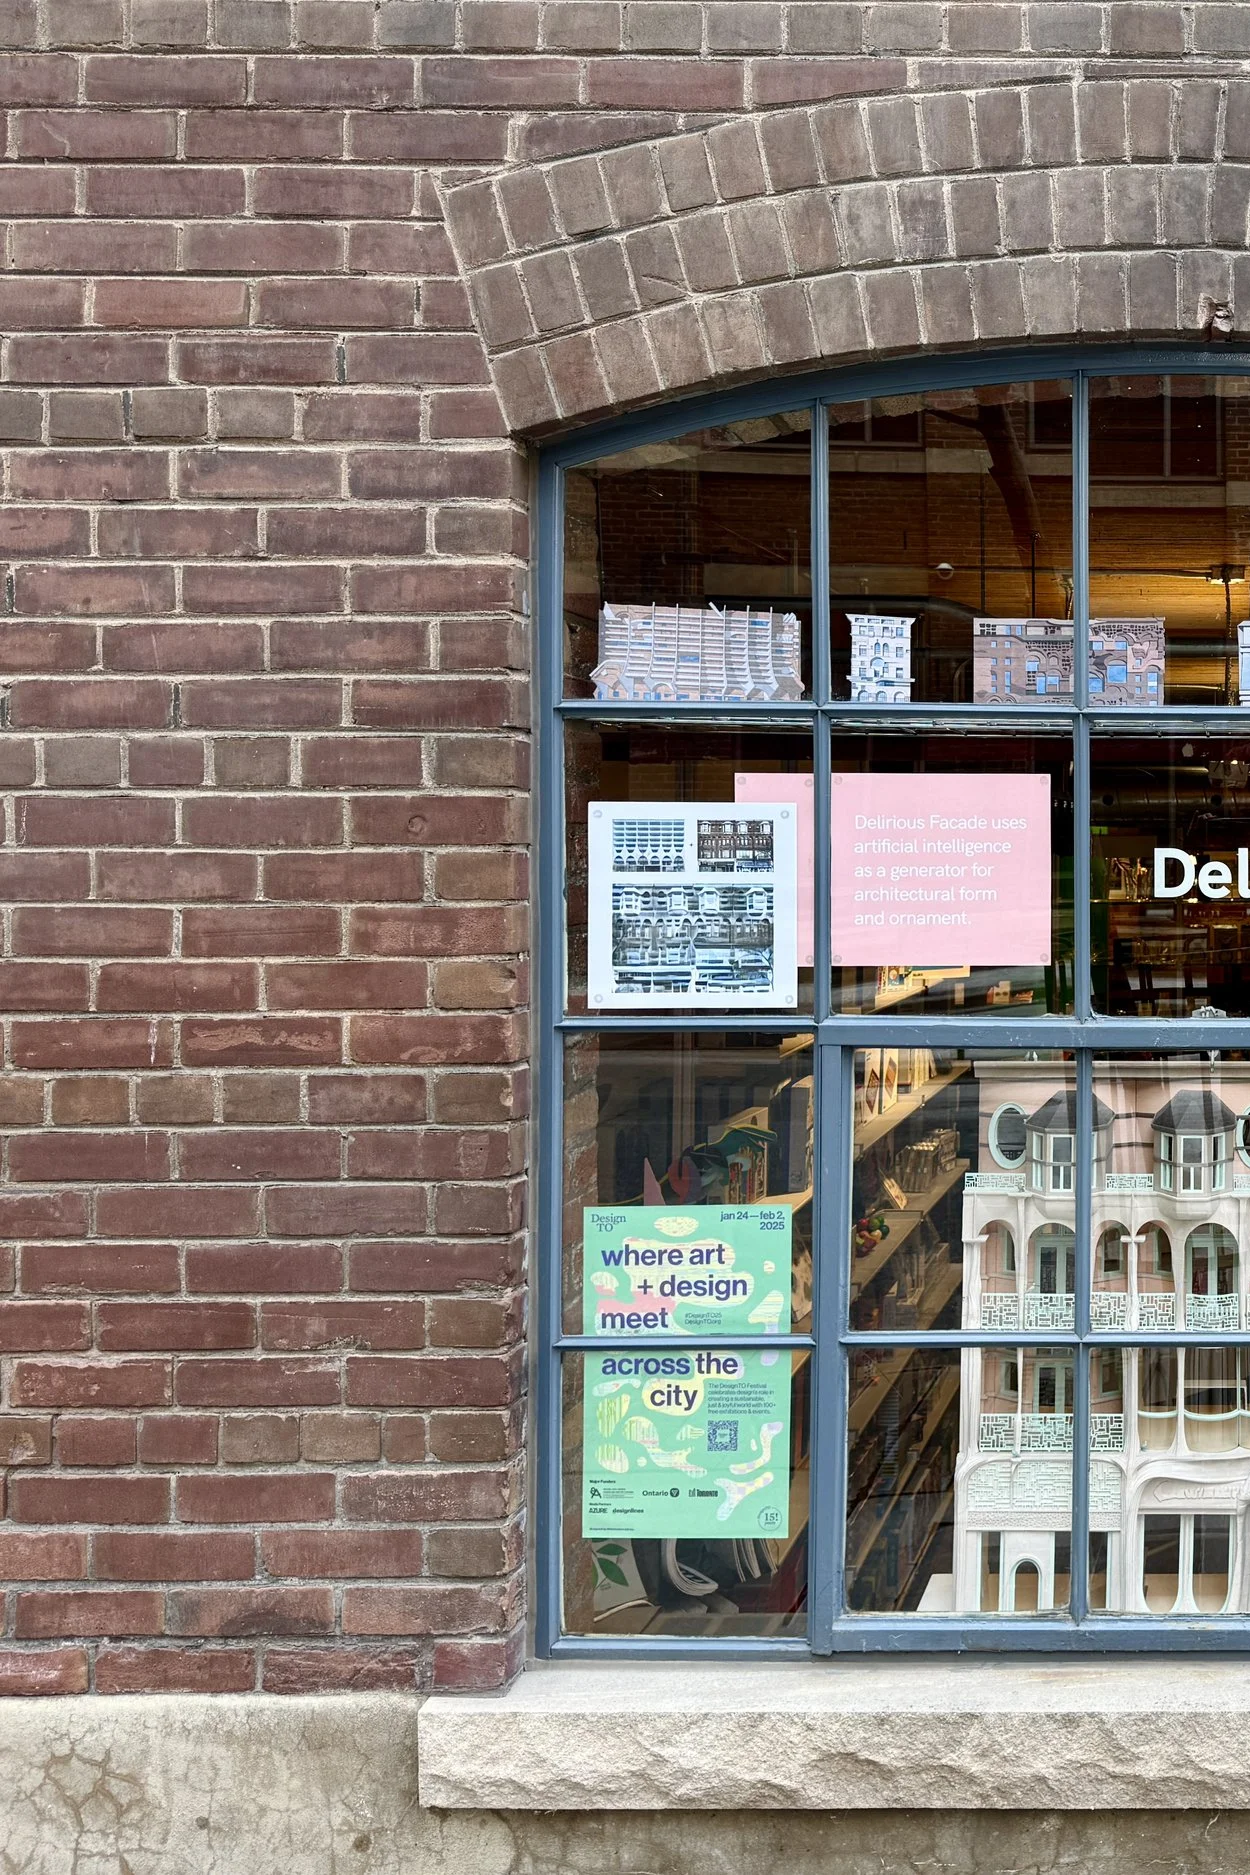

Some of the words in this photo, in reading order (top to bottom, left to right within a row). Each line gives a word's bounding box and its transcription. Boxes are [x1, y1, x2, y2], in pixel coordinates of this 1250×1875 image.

[855, 815, 925, 830] Delirious
[929, 815, 987, 830] Facade
[991, 818, 1028, 830] uses
[854, 839, 918, 853] artificial
[922, 839, 1012, 857] intelligence
[855, 866, 872, 878] as
[876, 866, 886, 878] a
[890, 865, 967, 881] generator
[971, 863, 994, 878] for
[854, 887, 955, 901] architectural
[959, 887, 997, 901] form
[854, 911, 885, 926] and
[889, 912, 972, 926] ornament.
[591, 1213, 626, 1224] Design
[720, 1212, 735, 1222] jan
[597, 1223, 614, 1232] TO
[760, 1221, 785, 1230] 2025
[601, 1244, 684, 1266] where
[689, 1244, 725, 1265] art
[638, 1279, 653, 1295] +
[659, 1275, 747, 1301] design
[601, 1308, 668, 1329] meet
[602, 1356, 690, 1375] across
[695, 1352, 738, 1375] the
[650, 1384, 698, 1411] city
[765, 1513, 778, 1521] 15!
